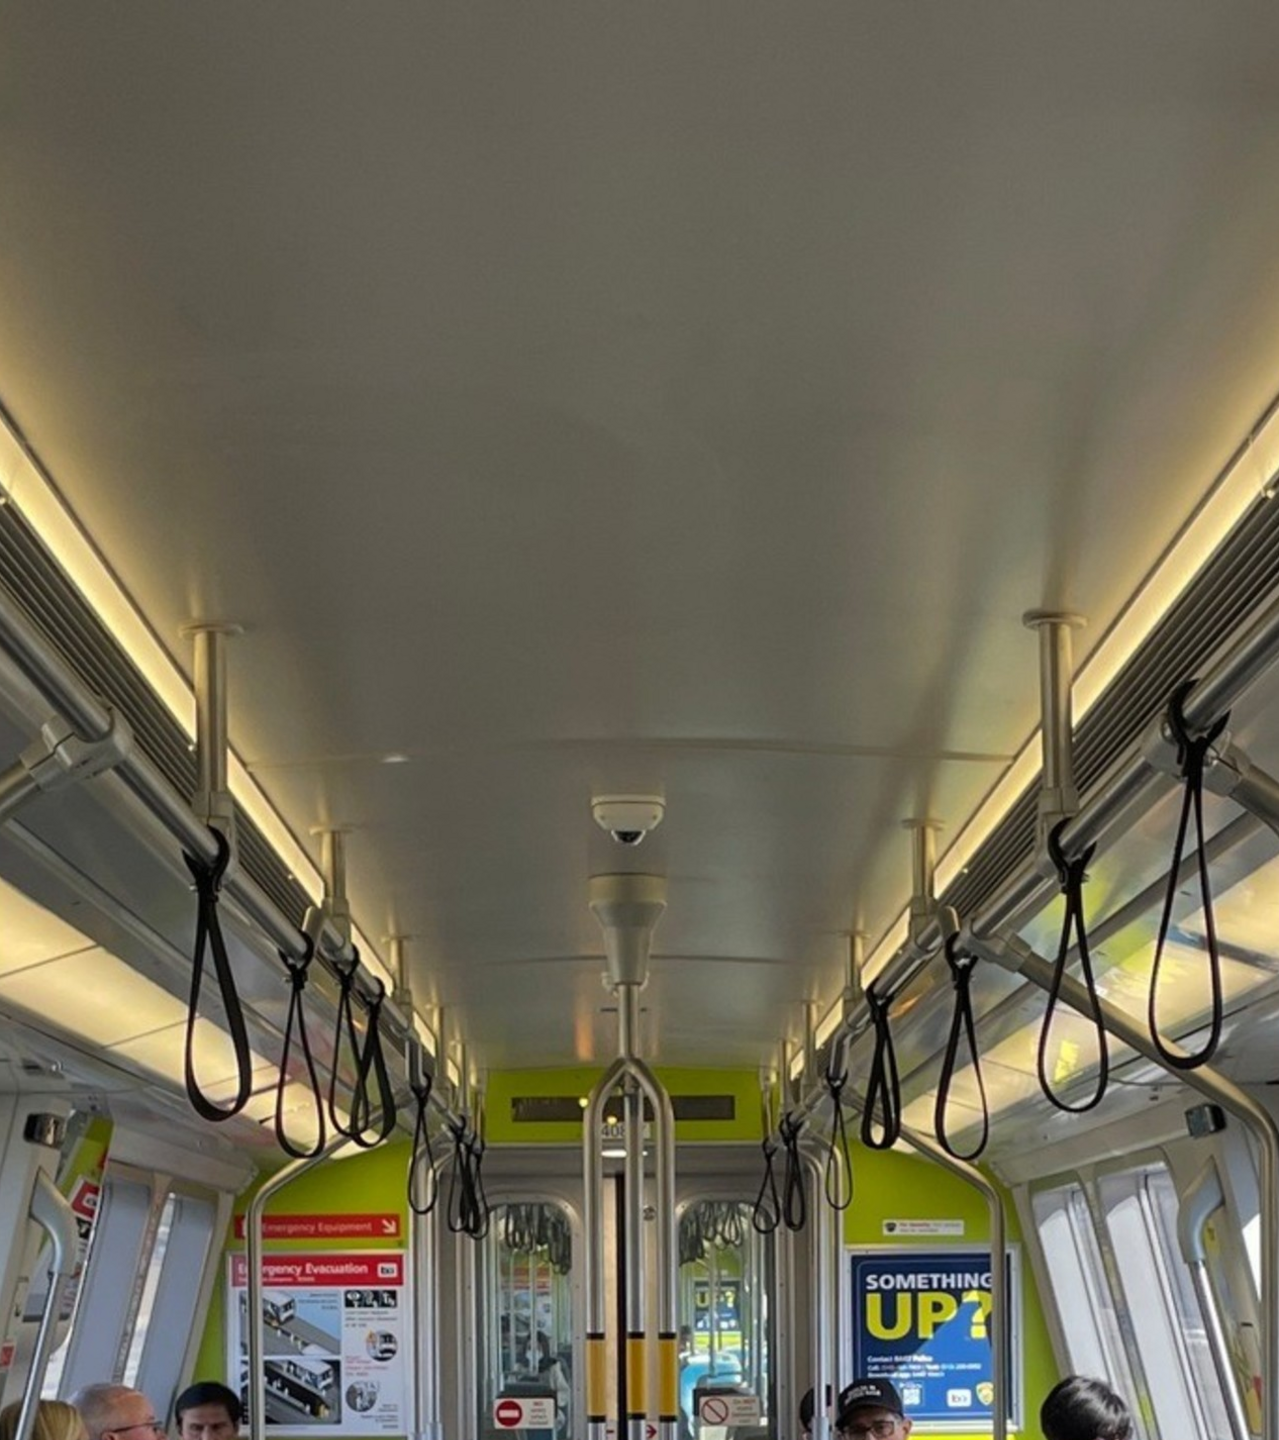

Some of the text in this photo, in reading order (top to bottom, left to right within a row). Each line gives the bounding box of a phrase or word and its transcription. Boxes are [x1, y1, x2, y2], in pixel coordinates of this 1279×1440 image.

[262, 1221, 373, 1234] Emergency Equipment
[238, 1262, 302, 1277] Ergency
[305, 1262, 369, 1275] Evacuation
[866, 1272, 992, 1290] SOMETHING
[865, 1290, 993, 1340] UP?
